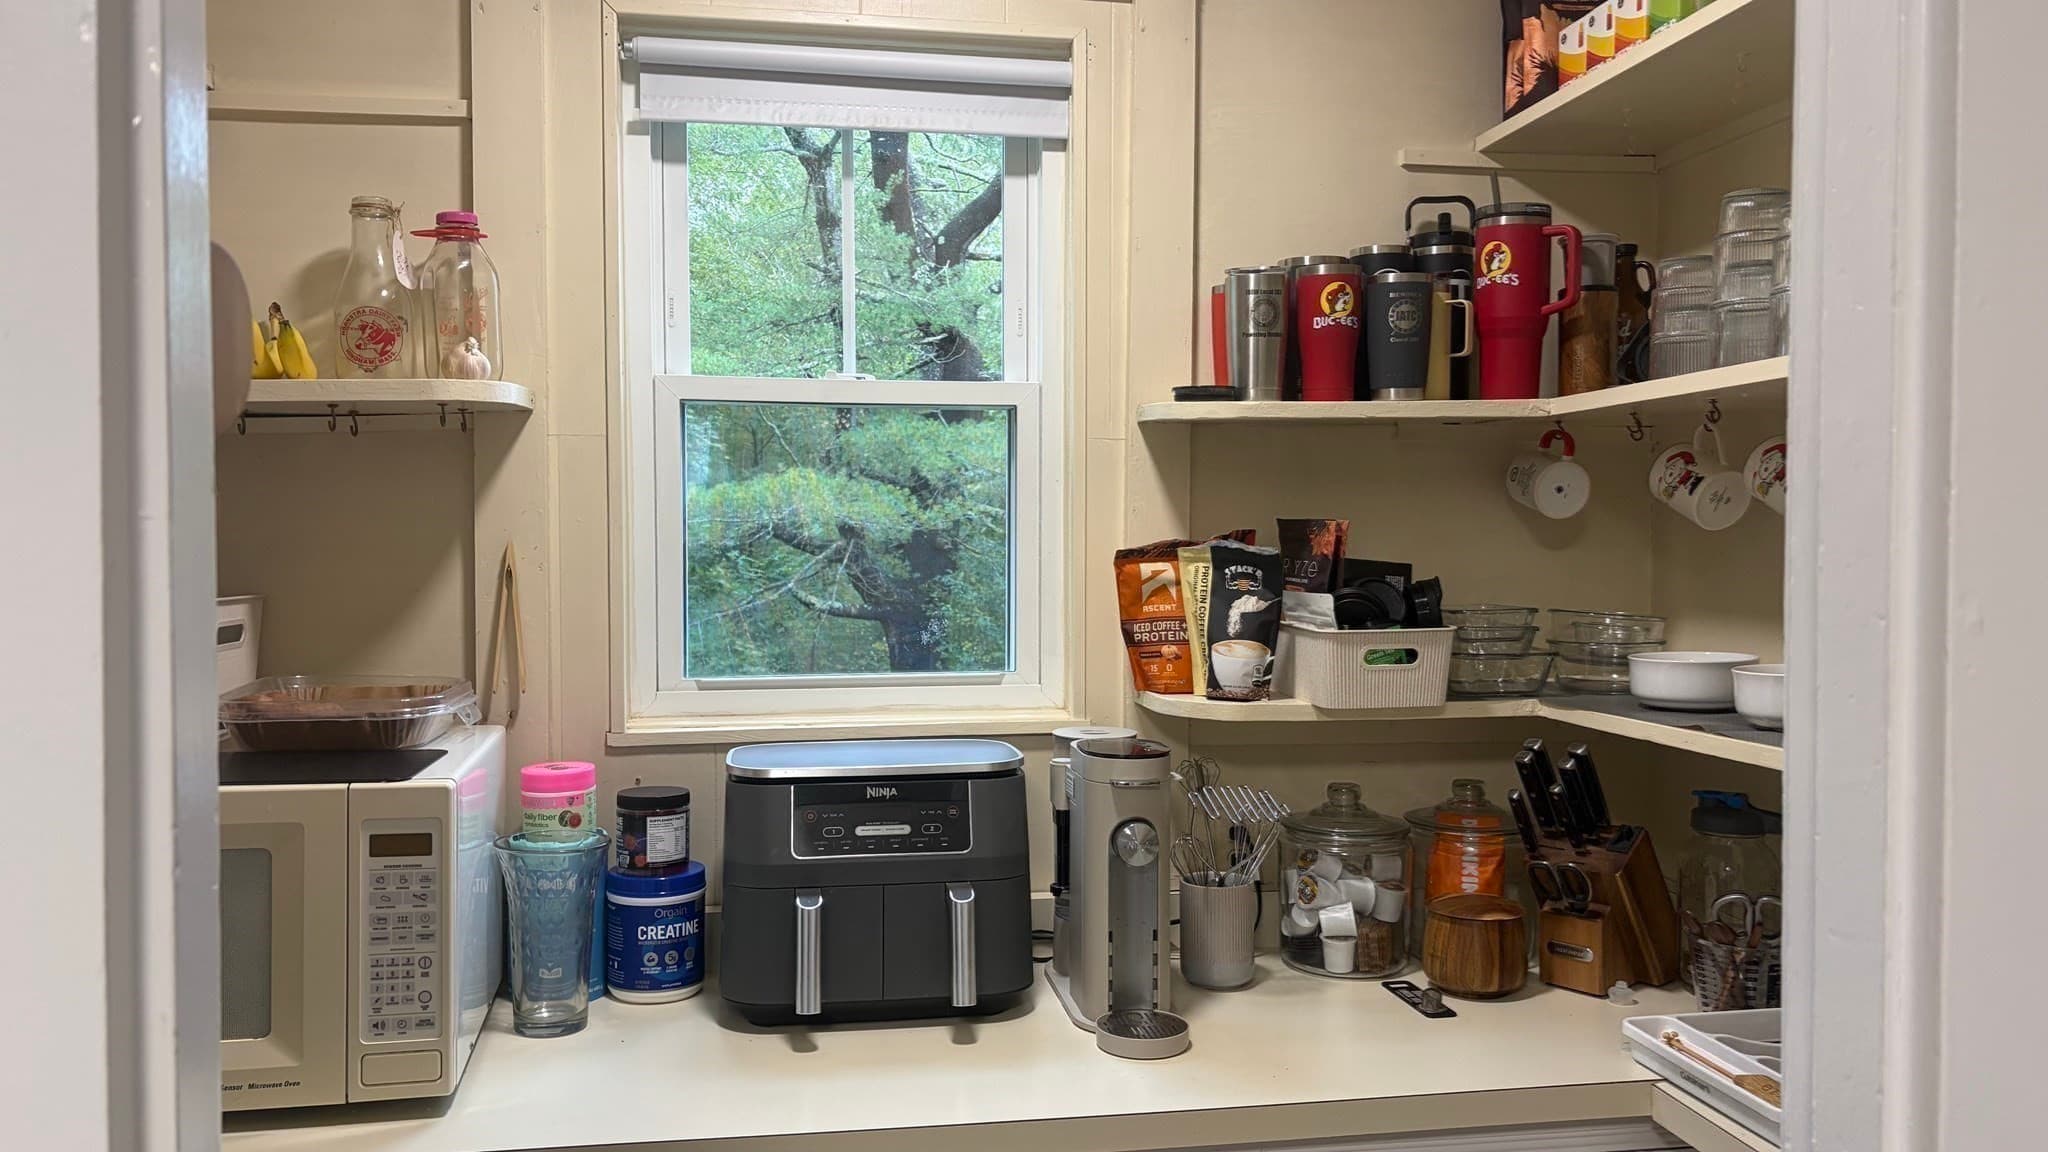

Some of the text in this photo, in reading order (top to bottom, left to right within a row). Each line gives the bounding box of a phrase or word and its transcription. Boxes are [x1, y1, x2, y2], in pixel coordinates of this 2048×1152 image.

[1199, 565, 1210, 604] PROTEIN
[1142, 603, 1177, 613] ASCENT
[1133, 622, 1151, 633] ICED
[1152, 620, 1180, 632] COFFEE
[1133, 631, 1189, 643] PROTEIN
[866, 785, 898, 799] NINJA
[537, 812, 558, 822] fiber
[654, 906, 688, 919] Orgain
[637, 918, 700, 941] CREATINE
[247, 1082, 283, 1090] Microwave
[283, 1080, 301, 1088] Oven
